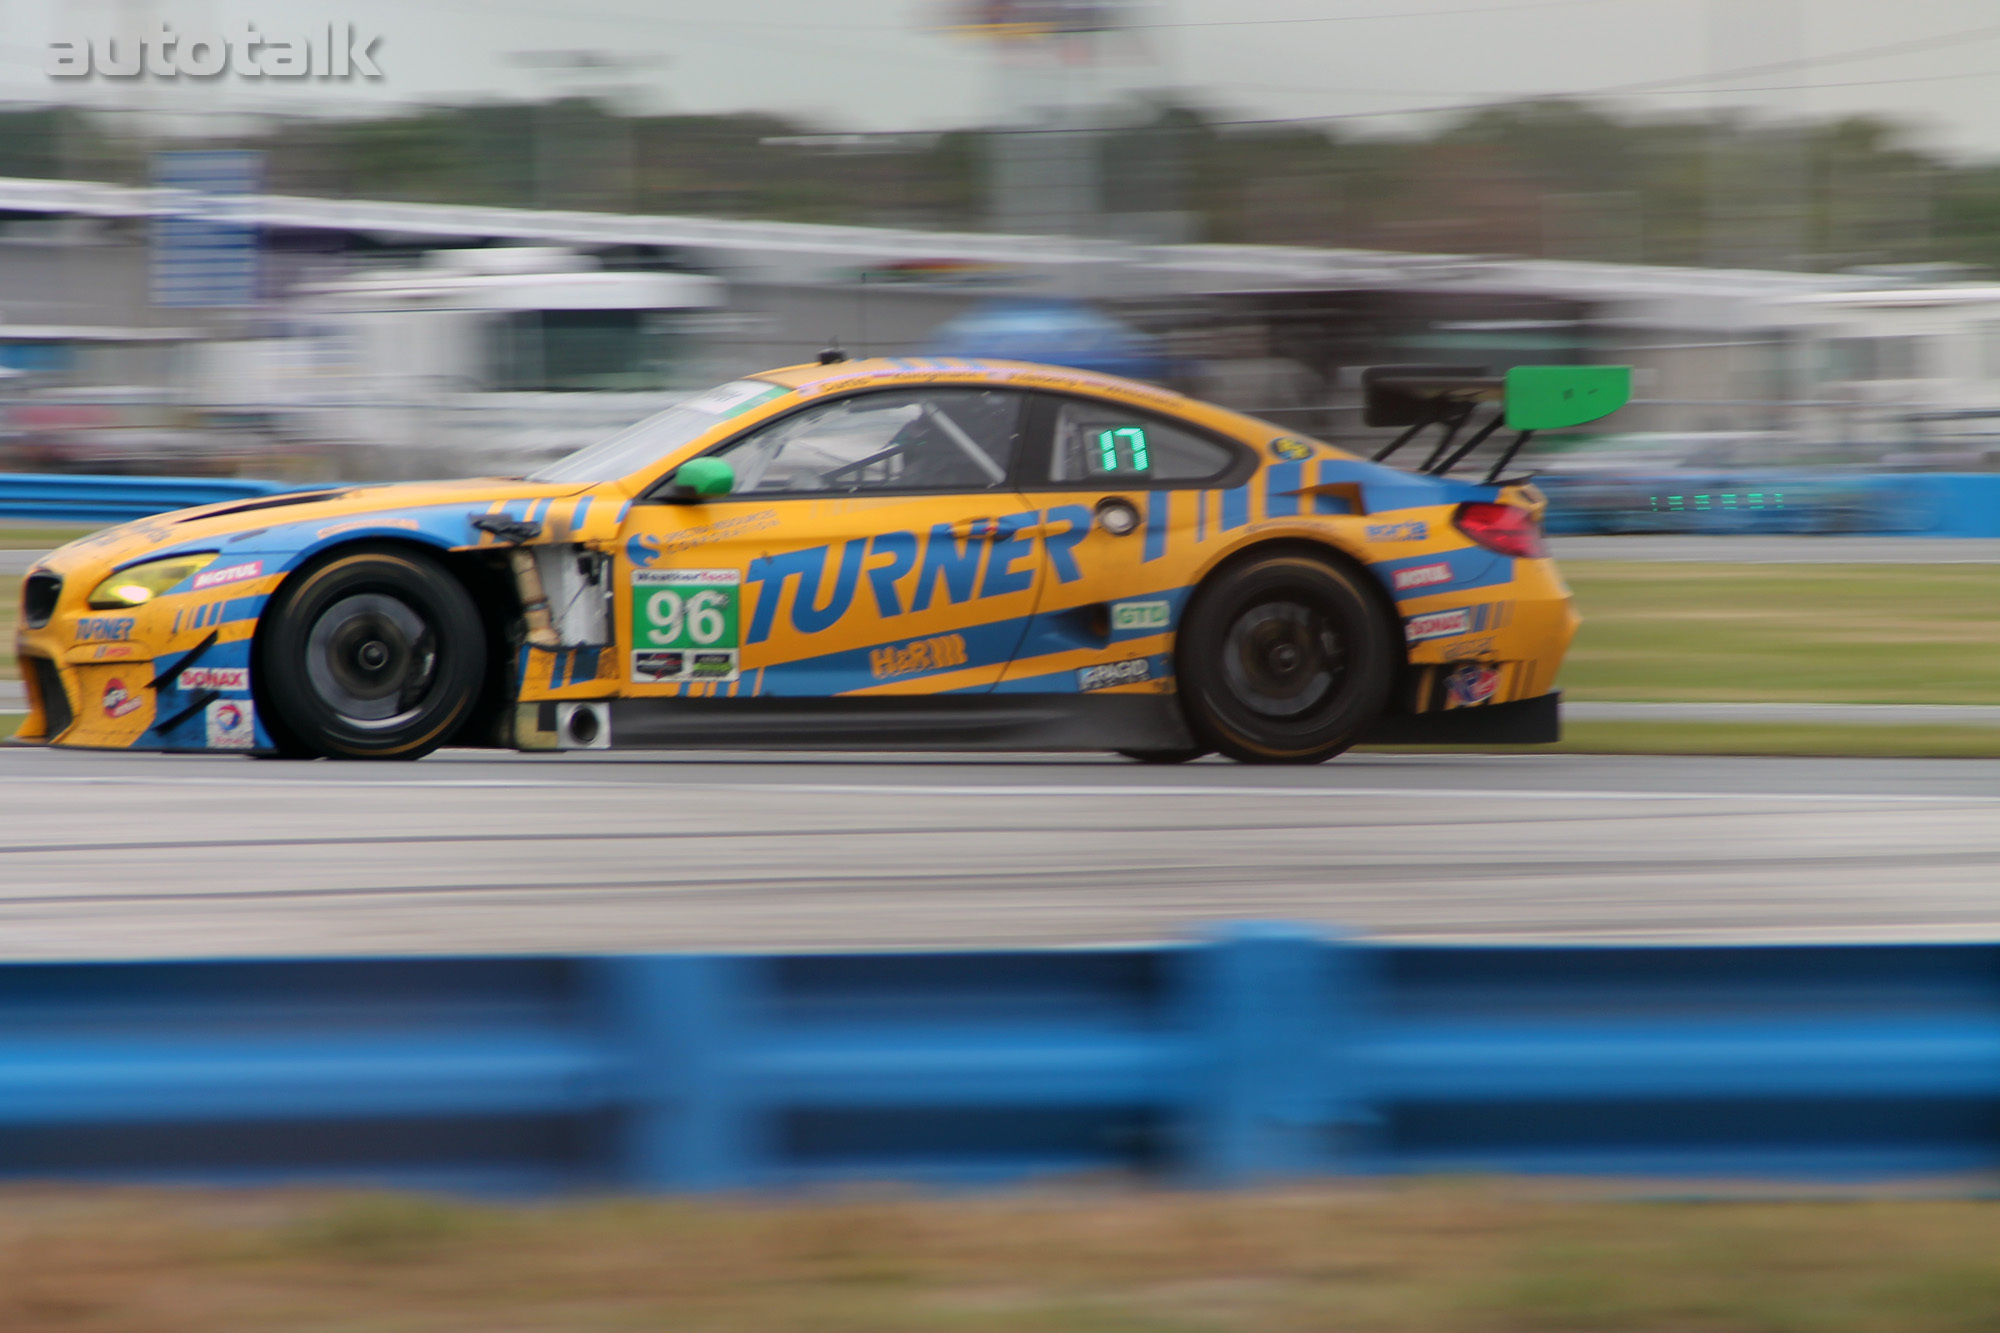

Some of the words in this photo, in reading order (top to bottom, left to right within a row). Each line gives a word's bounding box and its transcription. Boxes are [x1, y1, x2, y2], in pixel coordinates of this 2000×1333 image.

[1099, 427, 1149, 471] 17
[194, 562, 259, 589] MOTUL
[744, 503, 1093, 646] TURNER
[646, 589, 725, 645] 96
[1117, 605, 1169, 625] GTD
[74, 617, 135, 641] TURNER
[180, 670, 243, 688] SONAX
